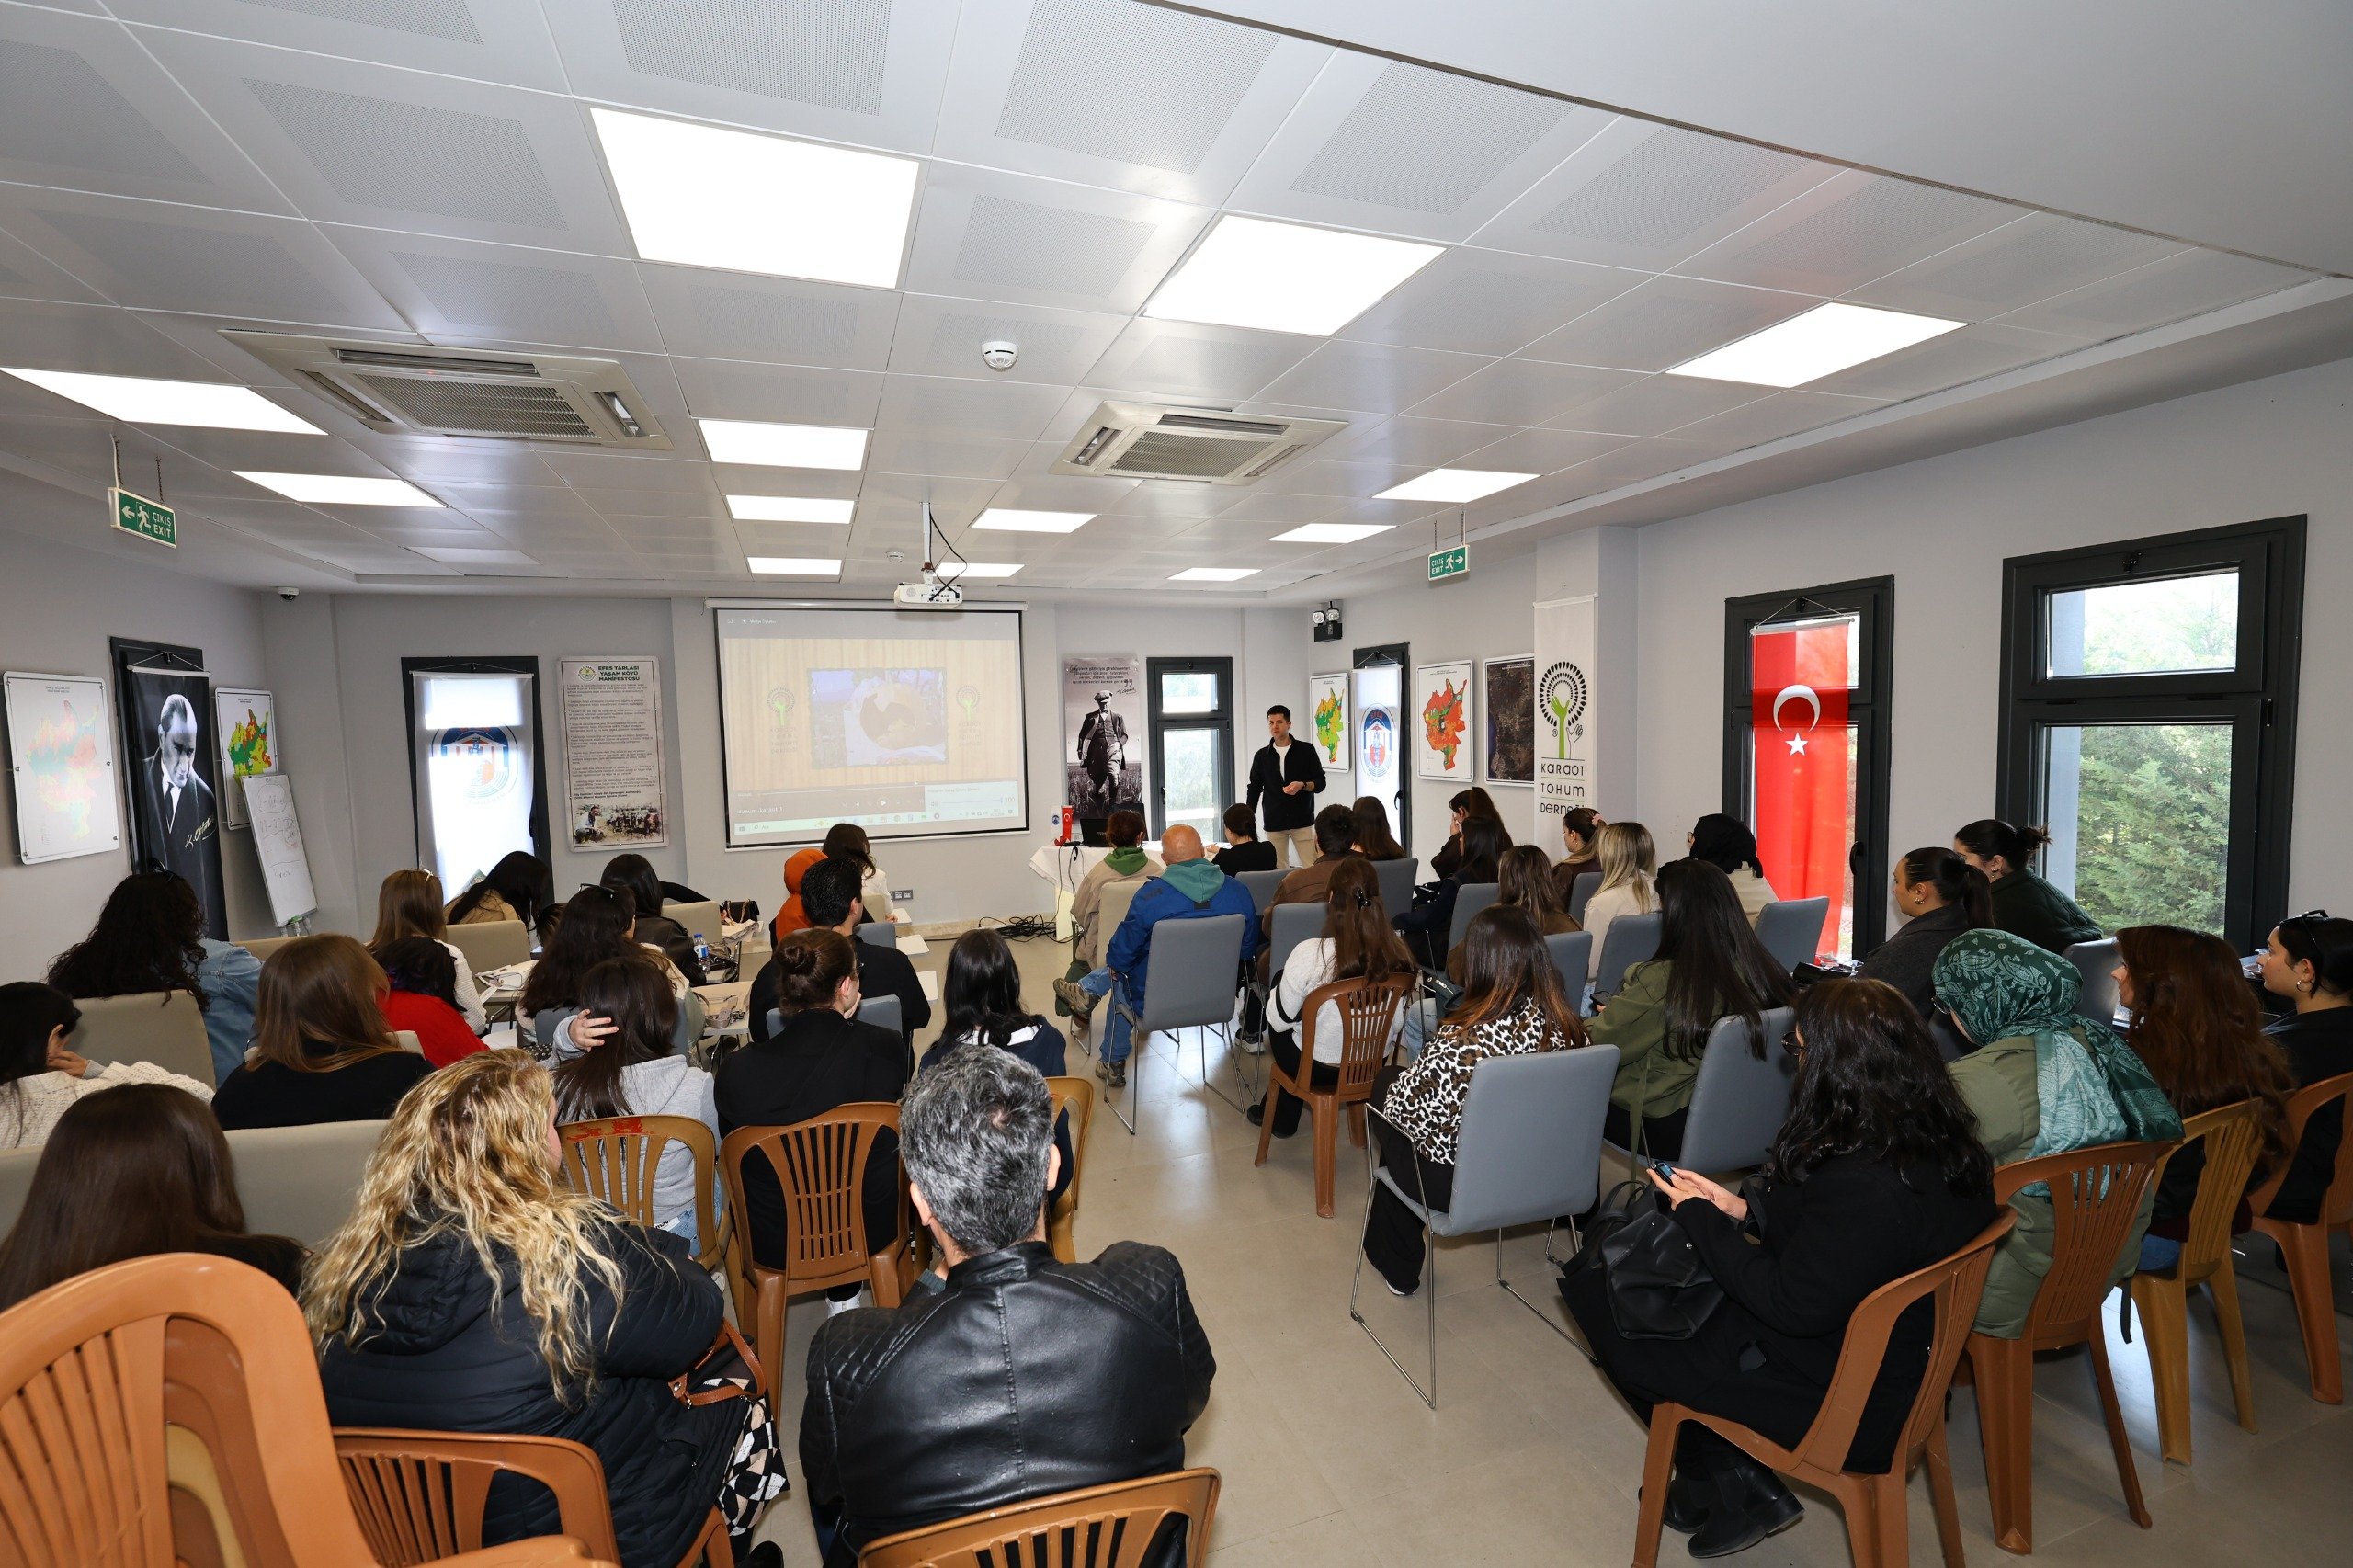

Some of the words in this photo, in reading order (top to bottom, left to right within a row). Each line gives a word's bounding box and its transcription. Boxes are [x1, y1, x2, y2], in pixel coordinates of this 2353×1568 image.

[153, 512, 172, 528] ÇIKIŞ
[153, 524, 172, 539] EXIT
[1431, 565, 1443, 574] EXIT
